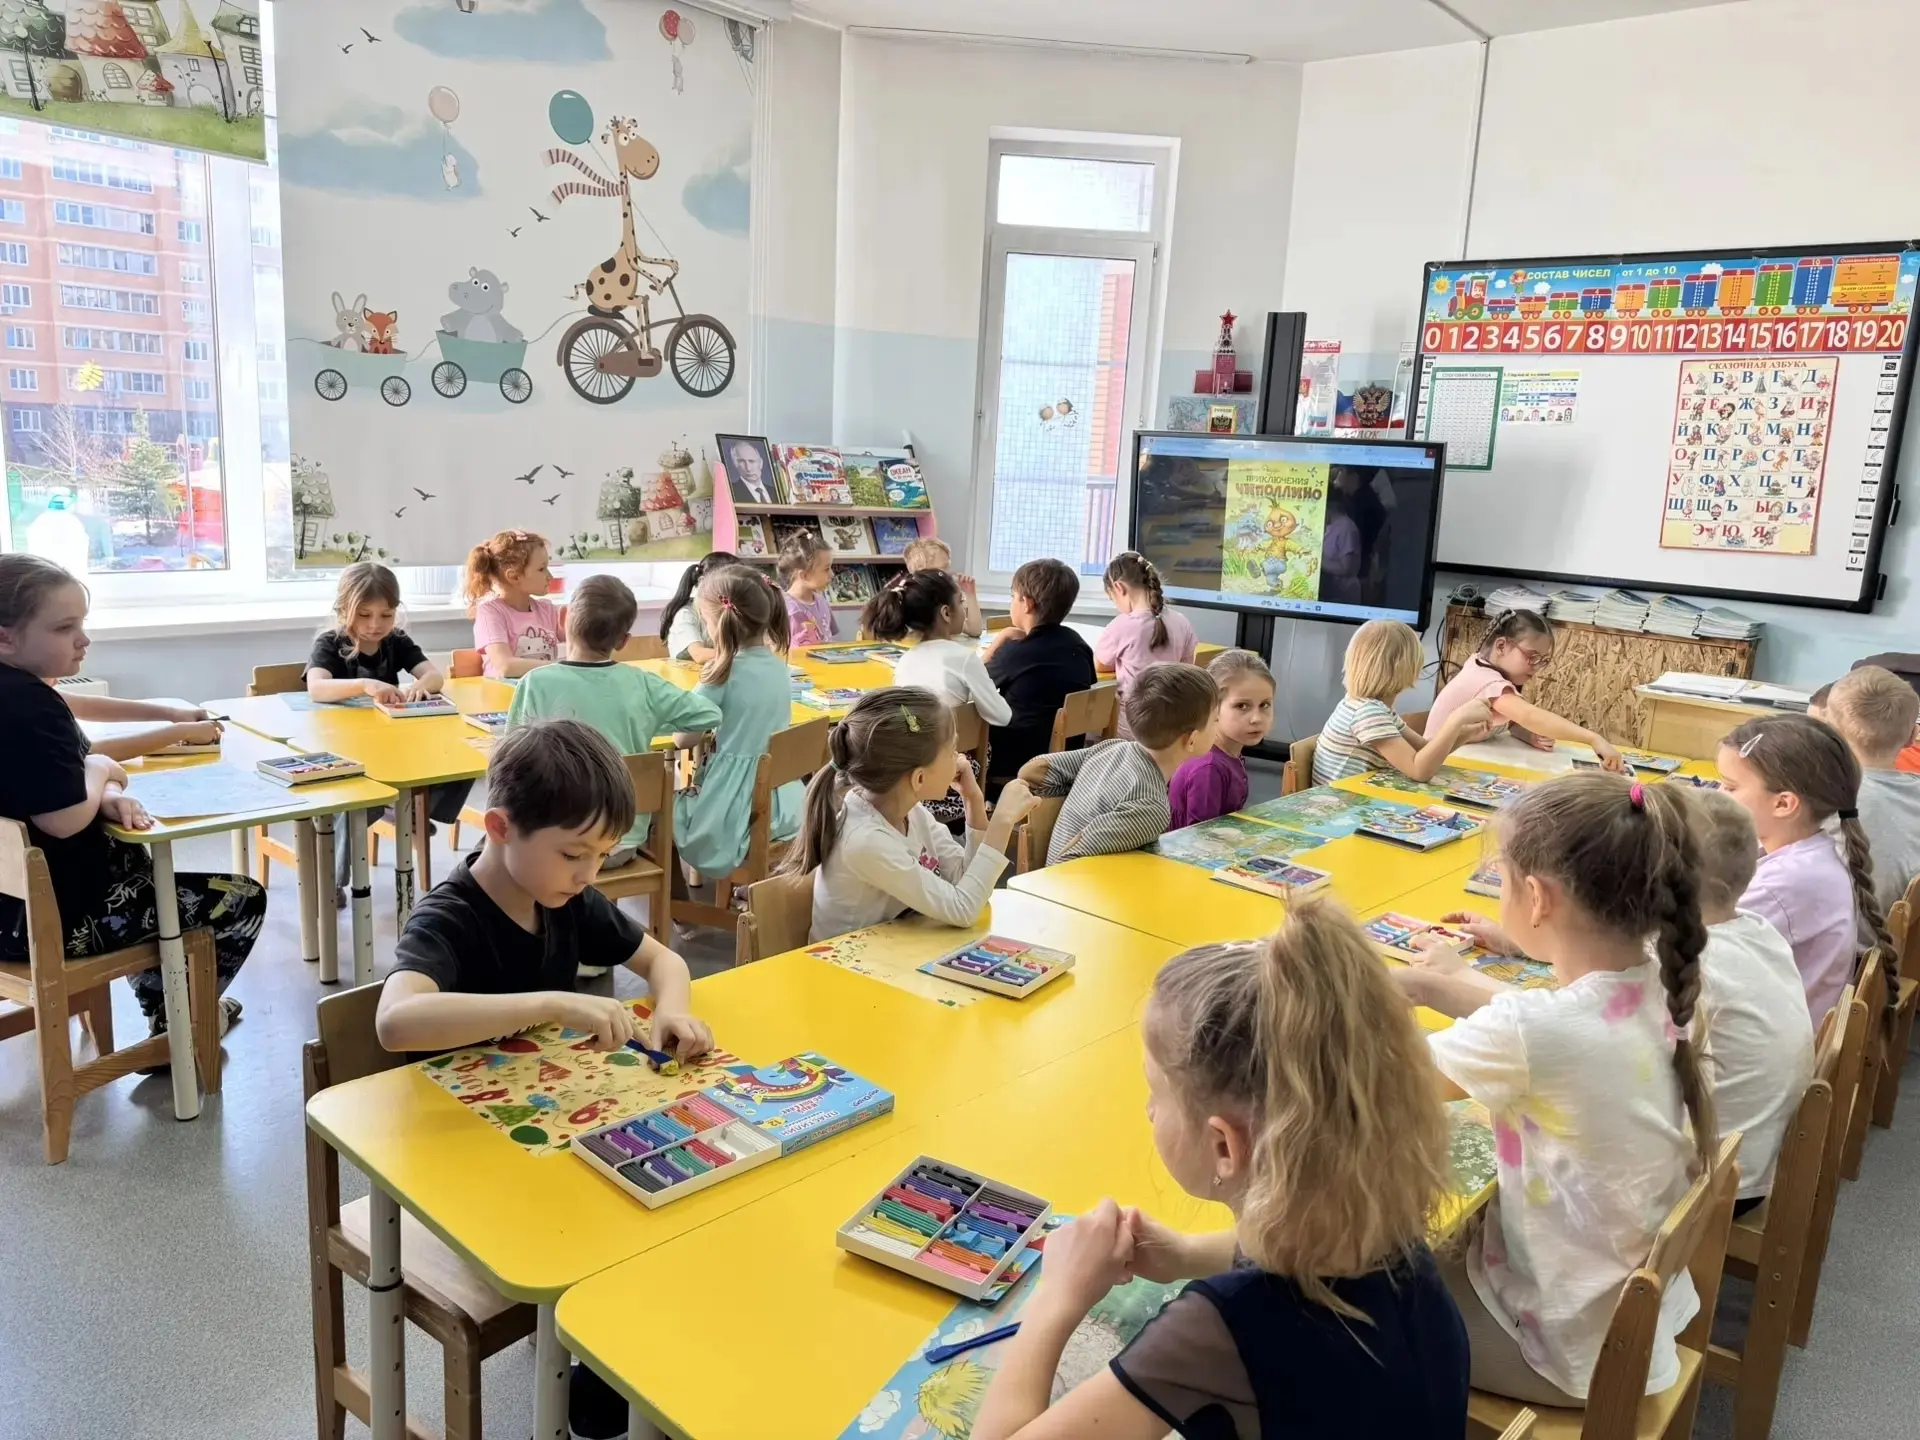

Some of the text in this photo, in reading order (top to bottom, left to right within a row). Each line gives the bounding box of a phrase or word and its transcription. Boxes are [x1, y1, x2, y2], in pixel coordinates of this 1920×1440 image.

[1526, 266, 1677, 280] СОСТАВ ЧИСЕЛ от 1 до 10
[1425, 320, 1906, 349] 0 1 2 3 4 5 6 7 8 9 10 11 12 13 14 15 16 17 18 19 20
[1708, 362, 1768, 370] СКАЗОЧНАЯ
[1683, 373, 1694, 385] А
[1713, 371, 1724, 384] Б
[1742, 371, 1753, 383] В
[1803, 369, 1817, 383] Д
[1680, 397, 1814, 410] Е Ё Ж З И
[1678, 423, 1810, 436] Й К Л М Н
[1675, 449, 1806, 461] О П Р С Т
[1246, 475, 1309, 485] ПРИКЛЮЧЕНИЯ
[1672, 473, 1803, 488] У Ф Х Ц Ч
[1236, 483, 1322, 500] ЧИПОЛЛИНО
[1668, 499, 1798, 514] Ш Щ Ъ Ы Ь
[1693, 524, 1767, 538] Э Ю Я
[780, 1110, 840, 1137] ПЛАСТИЛИН
